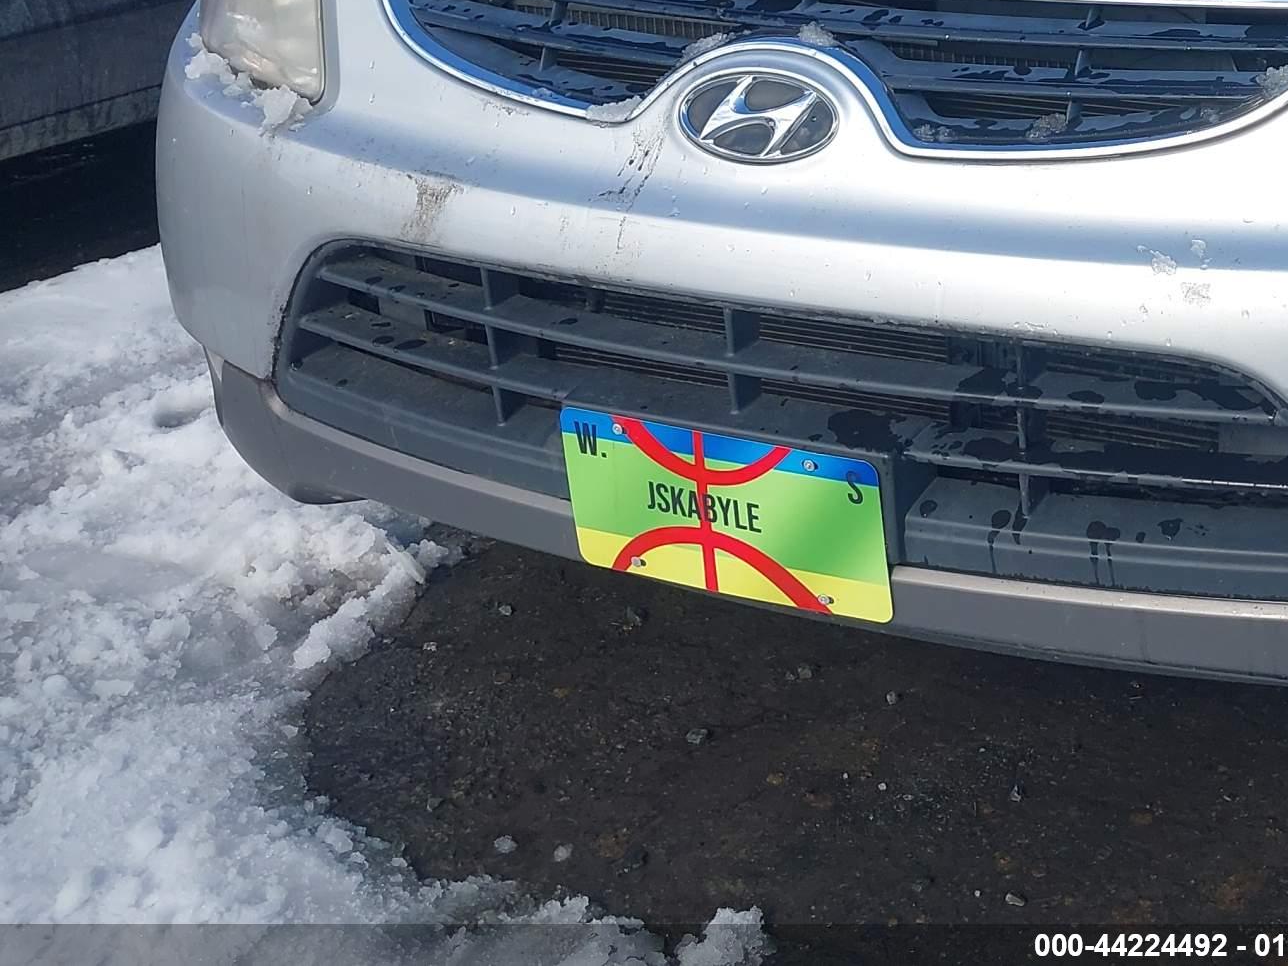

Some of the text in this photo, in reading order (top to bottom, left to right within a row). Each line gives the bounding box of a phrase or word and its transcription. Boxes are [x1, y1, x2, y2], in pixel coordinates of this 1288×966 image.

[573, 420, 607, 459] W.
[648, 481, 762, 533] JSKABYLE
[846, 470, 864, 505] S
